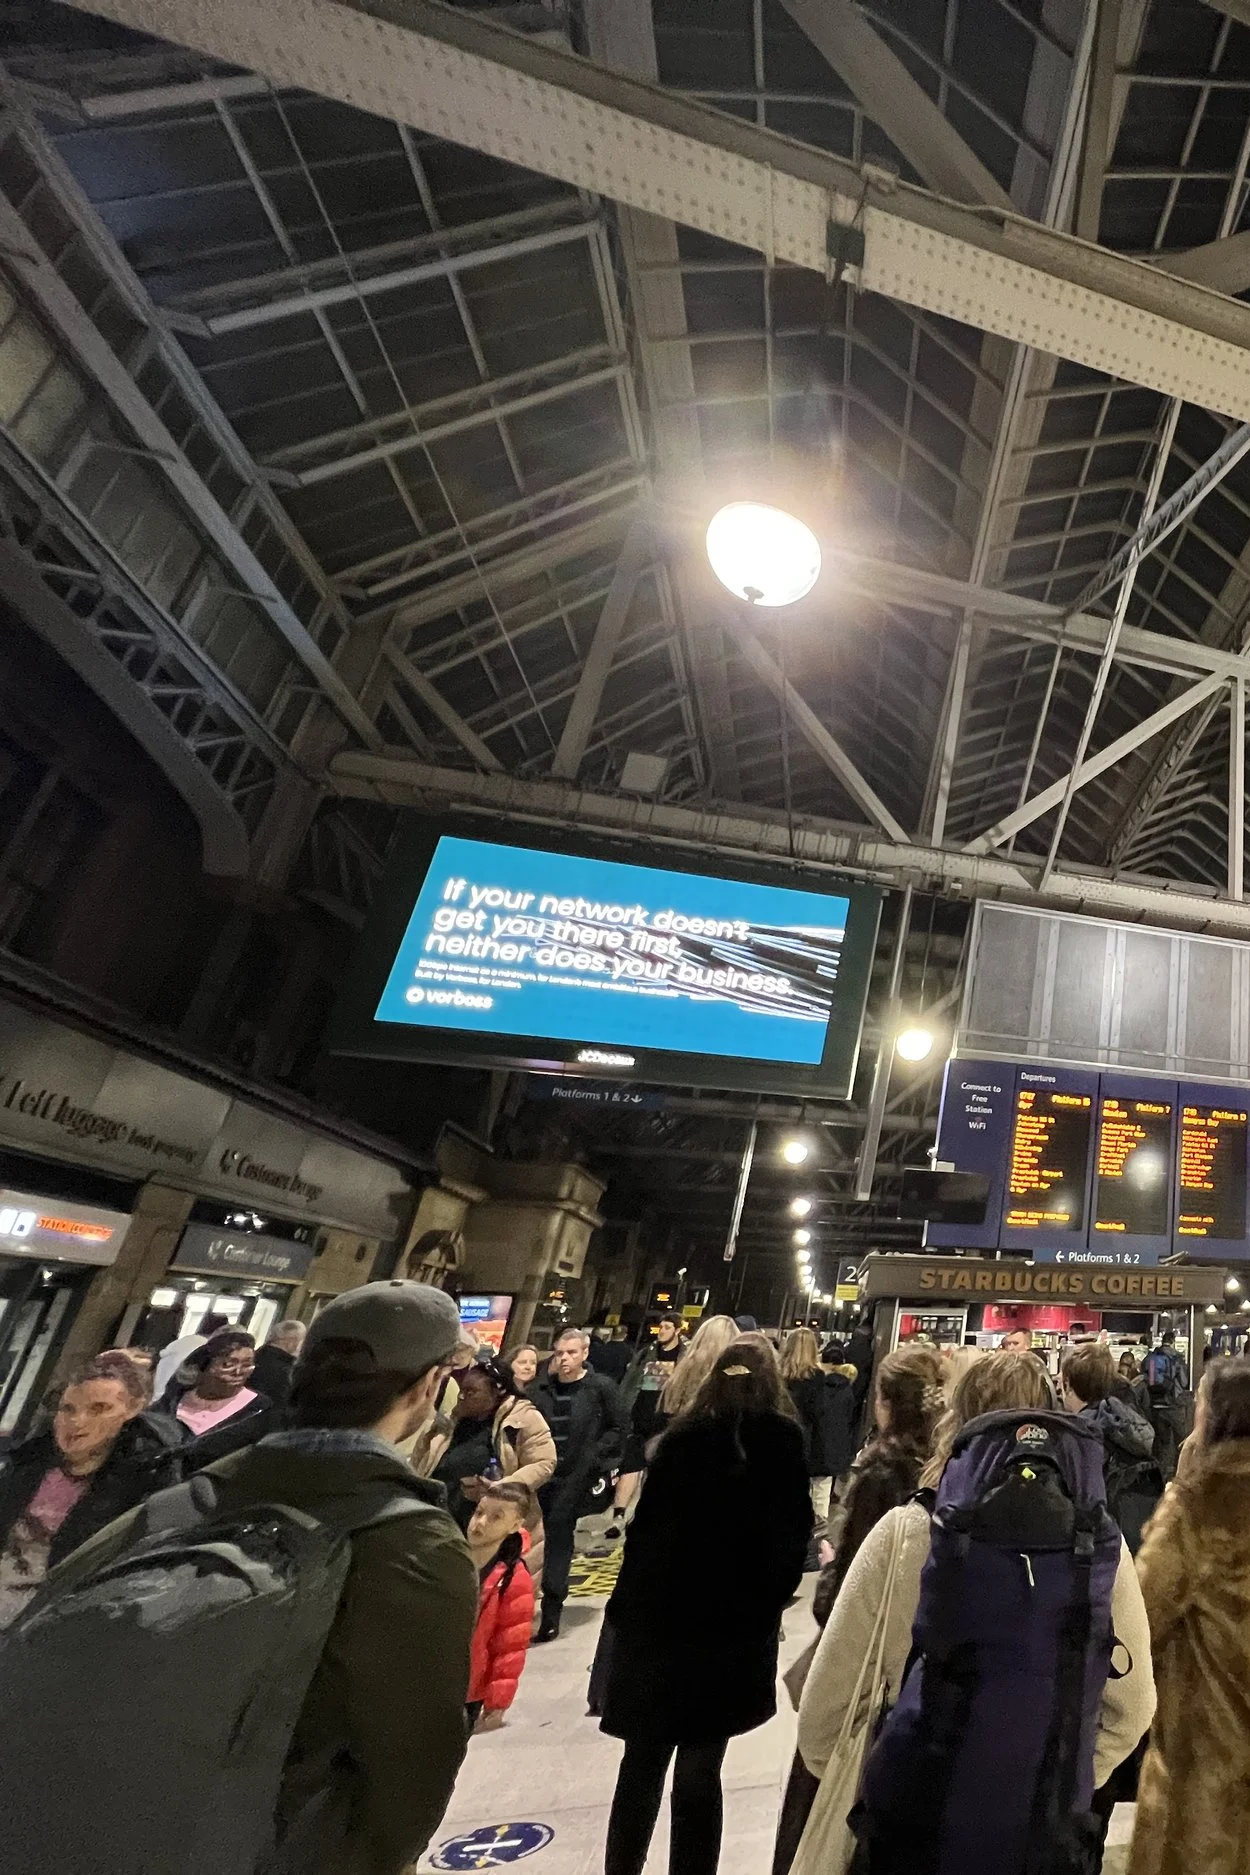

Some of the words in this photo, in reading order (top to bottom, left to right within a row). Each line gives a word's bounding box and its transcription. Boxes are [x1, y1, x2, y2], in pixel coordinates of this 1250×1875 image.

[444, 877, 467, 901] If
[468, 885, 535, 909] your
[539, 894, 650, 926] network
[653, 909, 750, 940] doesn't
[433, 907, 487, 931] get
[492, 914, 545, 938] you
[554, 920, 624, 948] there
[630, 929, 683, 958] first,
[425, 932, 530, 962] neither
[535, 945, 605, 971] does
[612, 955, 674, 979] your
[1021, 1072, 1056, 1083] Departures
[552, 1087, 600, 1101] Platforms
[604, 1092, 609, 1100] 1
[612, 1093, 620, 1102] &
[623, 1094, 630, 1102] 2
[961, 1082, 991, 1092] Connect
[965, 1105, 992, 1113] Station
[1069, 1252, 1113, 1263] Platforms
[1116, 1254, 1120, 1263] 1
[1124, 1254, 1132, 1263] &
[1134, 1254, 1140, 1264] 2
[844, 1266, 857, 1282] 2
[919, 1268, 1084, 1294] STARBUCKS
[1091, 1275, 1184, 1296] COFFEE
